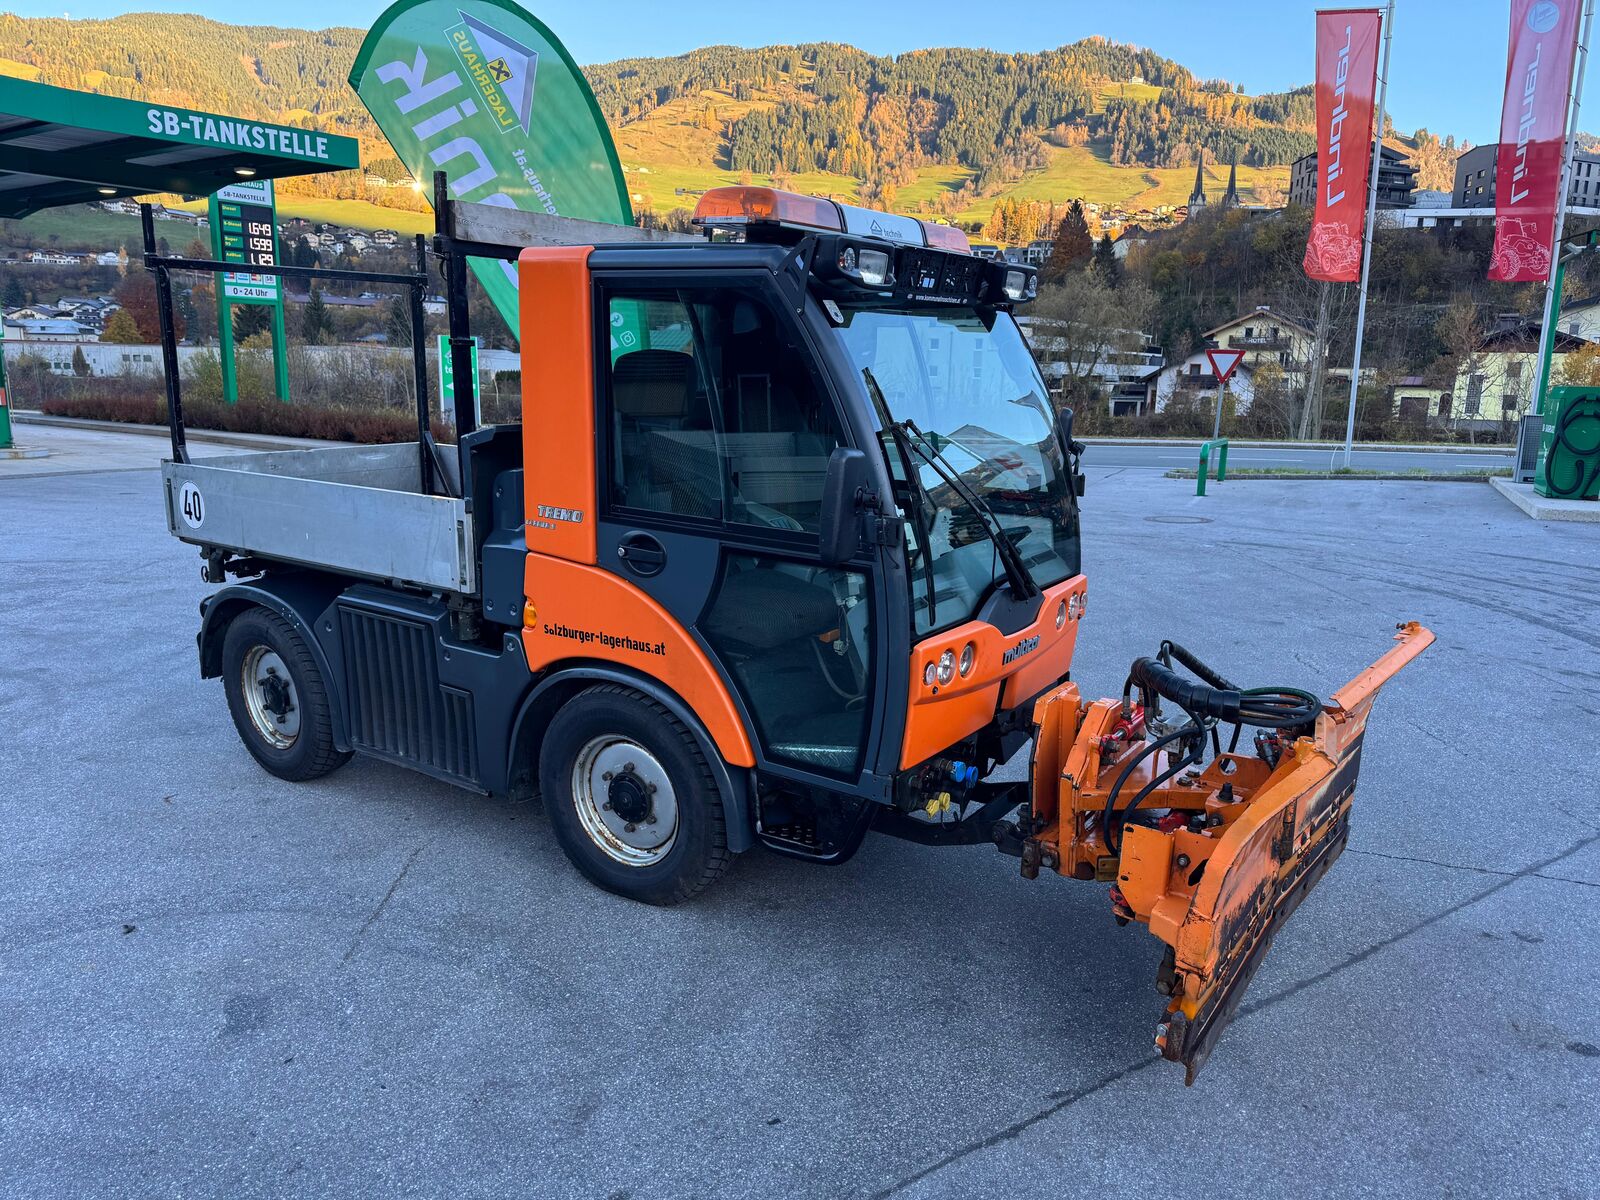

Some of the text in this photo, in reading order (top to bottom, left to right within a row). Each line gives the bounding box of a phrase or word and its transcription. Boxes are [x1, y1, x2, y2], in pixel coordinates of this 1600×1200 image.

[147, 108, 329, 159] SB-TANKSTELLE
[223, 190, 265, 202] SB-TANKSTELLE
[233, 287, 237, 295] 0
[244, 288, 253, 296] 24
[255, 289, 268, 297] Uhr
[184, 489, 202, 522] 40
[537, 504, 584, 523] TREMO
